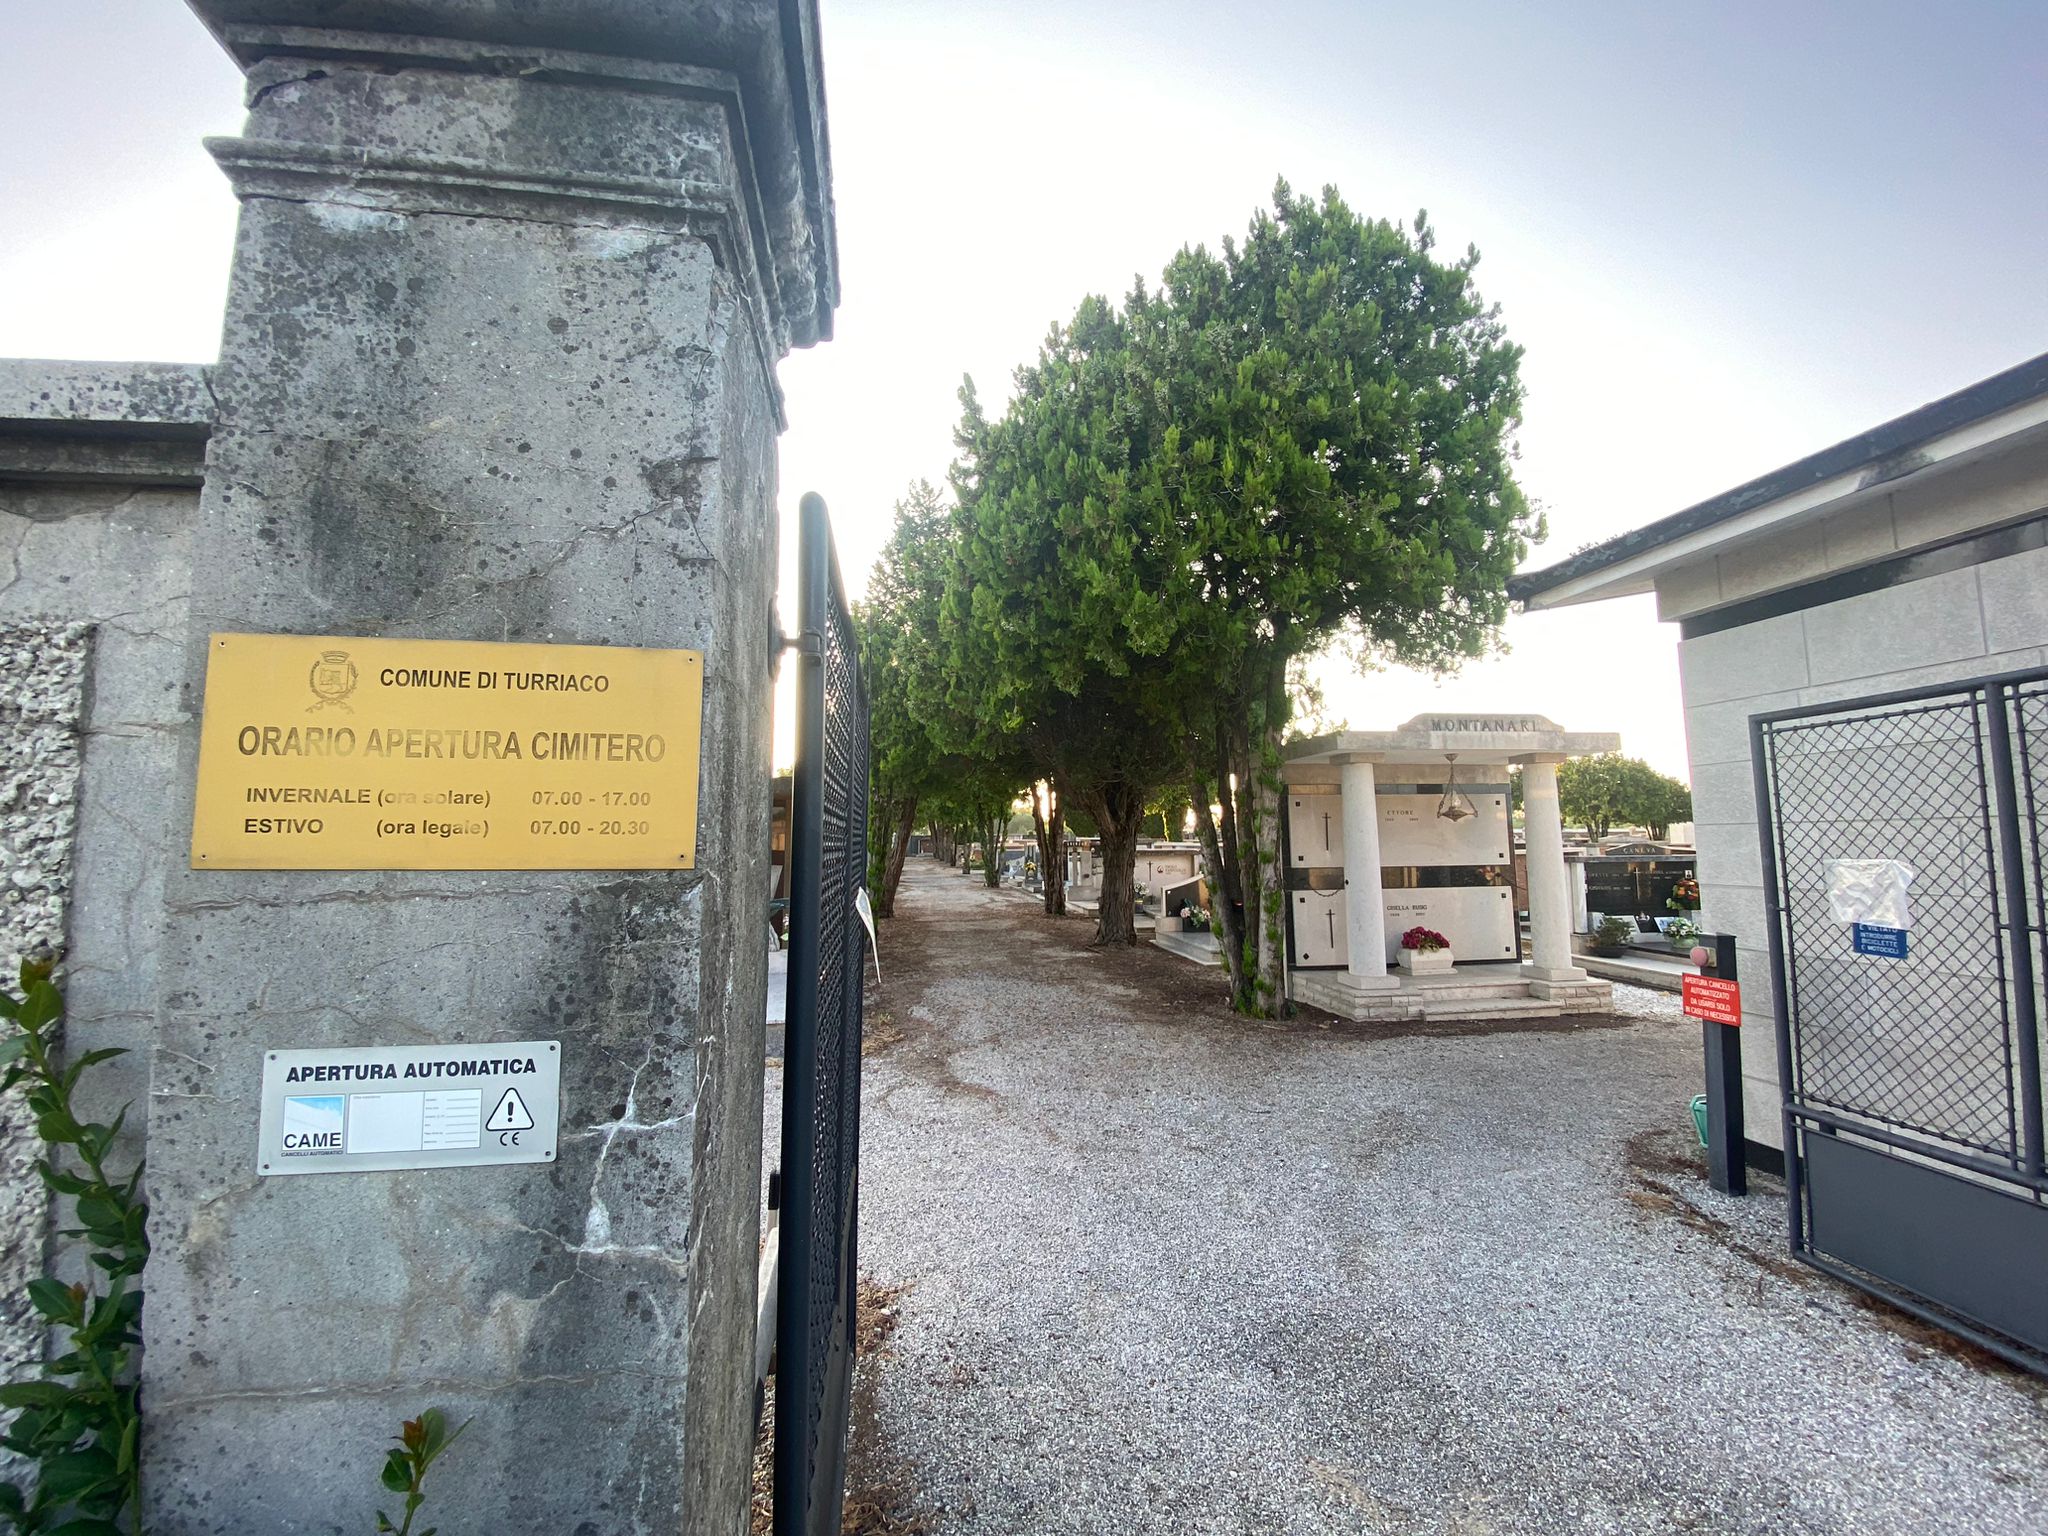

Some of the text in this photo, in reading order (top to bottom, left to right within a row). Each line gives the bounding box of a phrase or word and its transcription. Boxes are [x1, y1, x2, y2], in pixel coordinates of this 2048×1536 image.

[380, 668, 609, 692] COMUNE DI TURRIACO
[1431, 719, 1536, 732] MONTANARI
[238, 724, 666, 762] ORARIO APERTURA CIMITERO
[246, 786, 371, 804] INVERNALE
[377, 788, 420, 808] (ora
[423, 788, 491, 809] solare)
[531, 790, 583, 806] 07.00
[602, 790, 651, 807] 17.00
[244, 817, 324, 835] ESTIVO
[376, 818, 418, 837] (ora
[422, 818, 490, 838] legale)
[530, 820, 581, 836] 07.00
[599, 820, 650, 836] 20.30
[1861, 938, 1898, 947] BICICLETTE
[1867, 945, 1899, 954] MOTOCICLI
[1685, 977, 1735, 991] APERTURA CANCELLO
[1691, 987, 1729, 1000] AUTOMATIZZATO
[1698, 999, 1716, 1008] USARSI
[1716, 1003, 1731, 1011] SOLO
[286, 1058, 537, 1082] APERTURA AUTOMATICA
[283, 1132, 342, 1149] CAME
